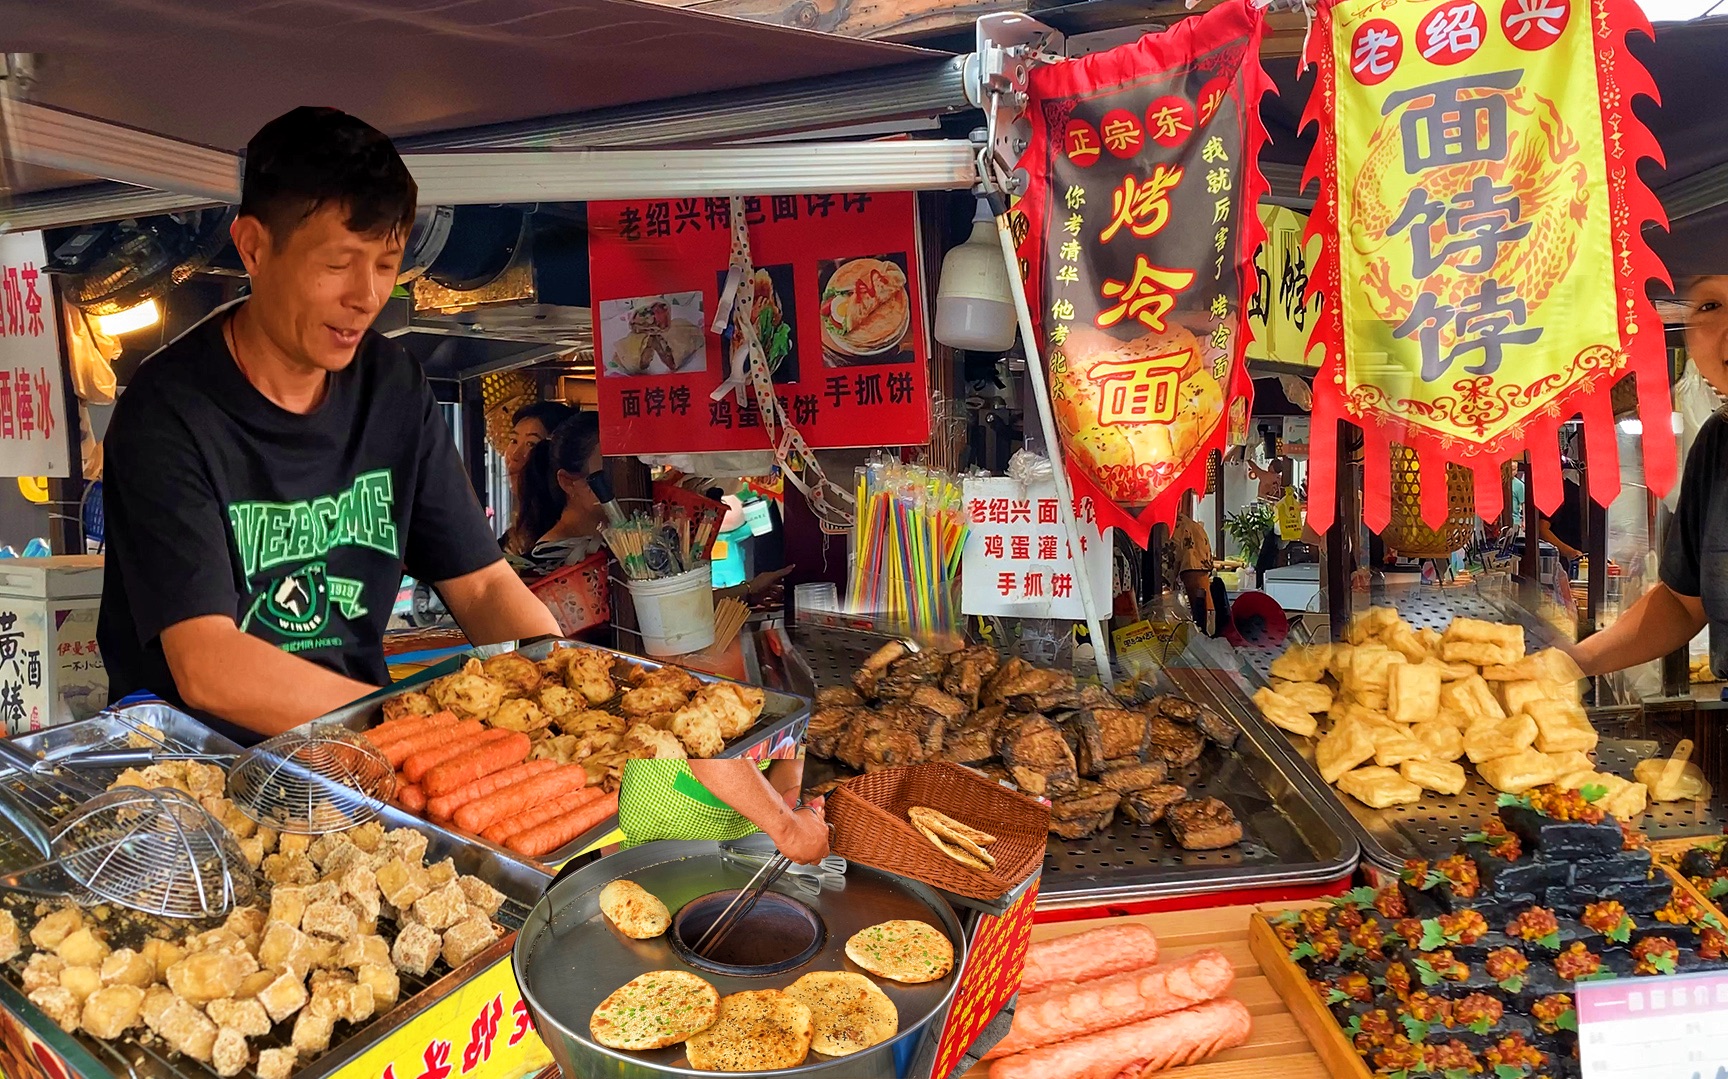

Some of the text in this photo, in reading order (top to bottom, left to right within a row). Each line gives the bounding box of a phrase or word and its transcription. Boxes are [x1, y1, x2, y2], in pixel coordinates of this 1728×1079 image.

[1354, 0, 1566, 74] 老绍兴
[1068, 87, 1227, 158] 正宗东北
[1055, 185, 1087, 287] 你考清华
[1201, 135, 1232, 281] 我就厉害了
[1381, 69, 1543, 382] 面饽饽
[0, 261, 44, 337] 奶茶
[1087, 163, 1197, 427] 烤冷面
[1048, 298, 1075, 401] 他考北大
[1209, 293, 1231, 381] 烤冷面
[620, 384, 692, 418] 面饽饽
[823, 371, 915, 407] 手抓饼
[997, 572, 1073, 598] 手抓饼
